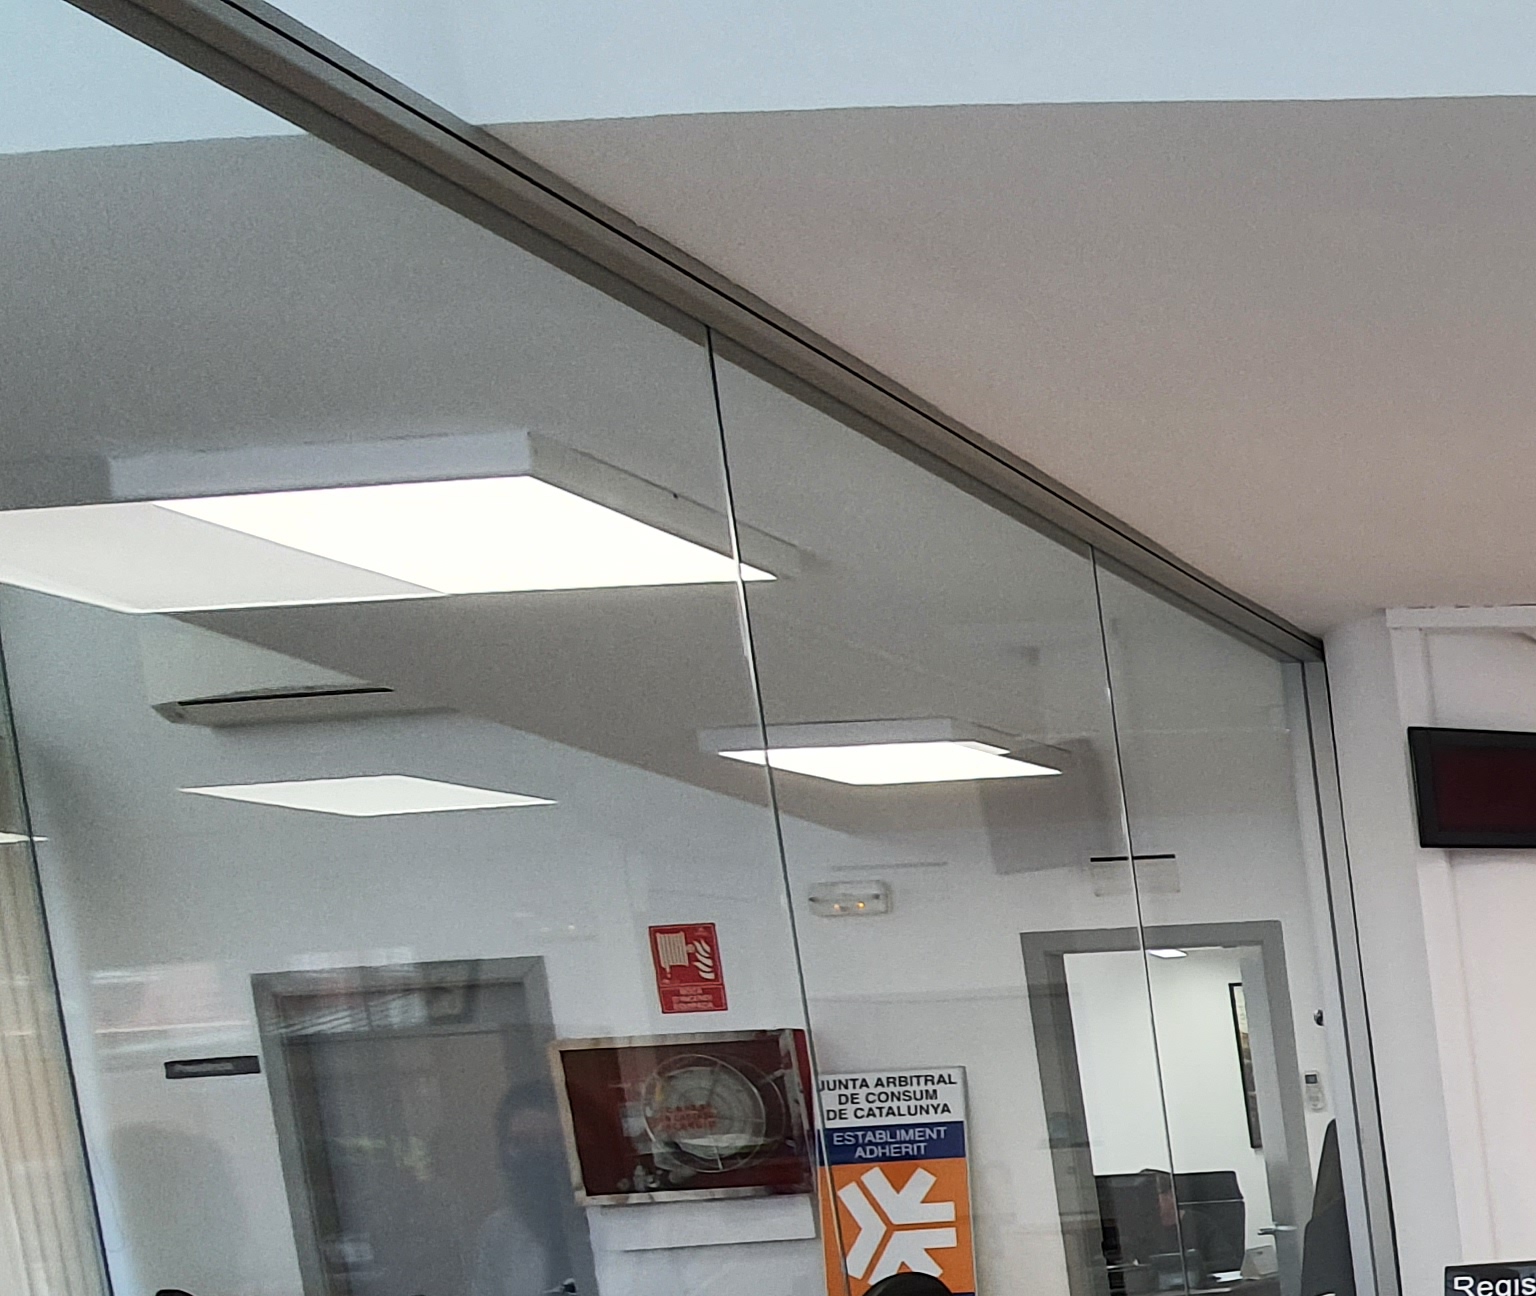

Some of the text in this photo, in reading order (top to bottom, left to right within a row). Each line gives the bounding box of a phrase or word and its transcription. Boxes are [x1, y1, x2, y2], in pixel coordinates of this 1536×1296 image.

[819, 1073, 958, 1093] JUNTA ARBITRAL
[837, 1089, 938, 1105] DE CONSUM
[826, 1102, 952, 1121] DE CATALUNYA
[832, 1126, 948, 1146] ESTABLIMENT
[854, 1142, 928, 1160] ADHERIT
